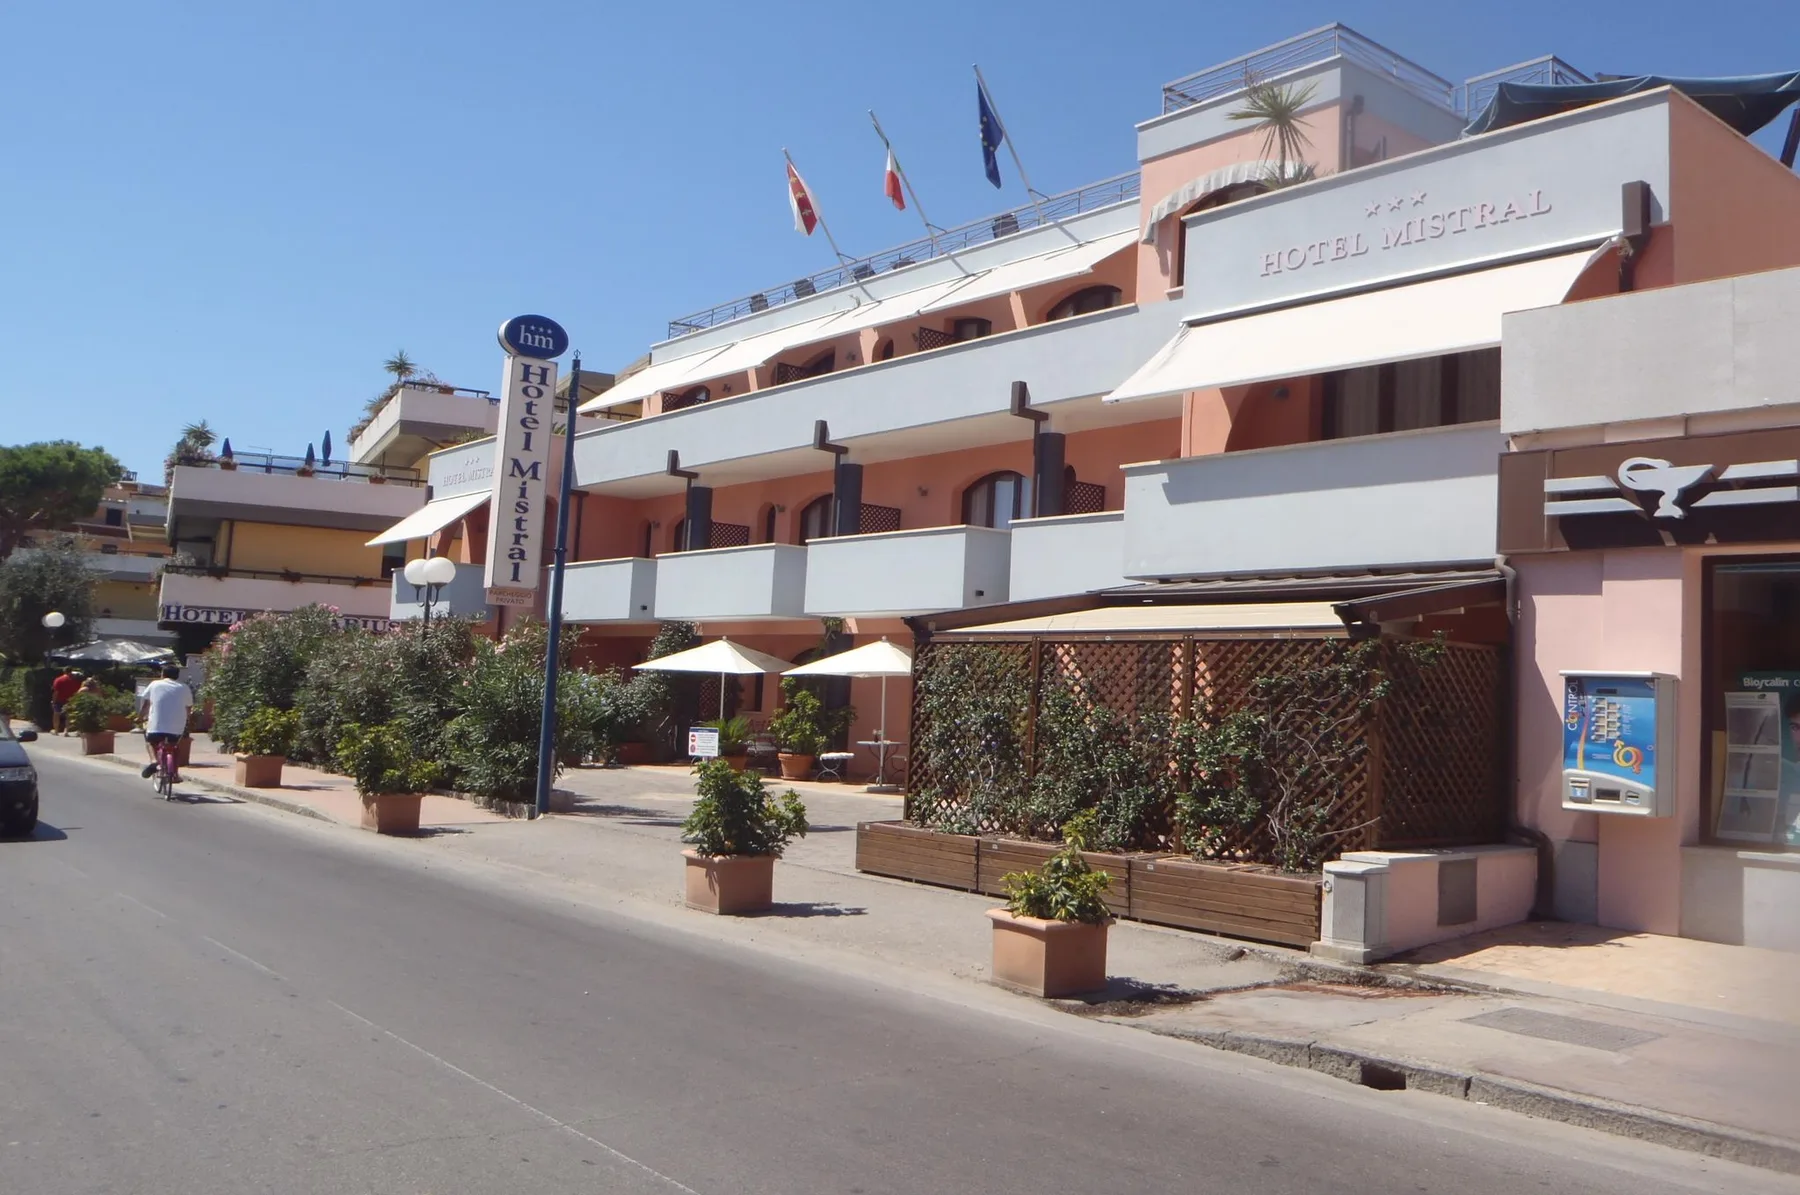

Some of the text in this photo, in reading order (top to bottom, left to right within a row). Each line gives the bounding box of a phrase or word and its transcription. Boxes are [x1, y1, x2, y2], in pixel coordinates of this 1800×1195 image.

[1260, 190, 1553, 277] HOTEL MISTRAL
[519, 324, 554, 350] hm
[443, 472, 466, 487] HOTEL
[507, 362, 550, 582] Hotel Mistral
[164, 603, 246, 624] HOTEL
[1566, 680, 1579, 731] CONTROL
